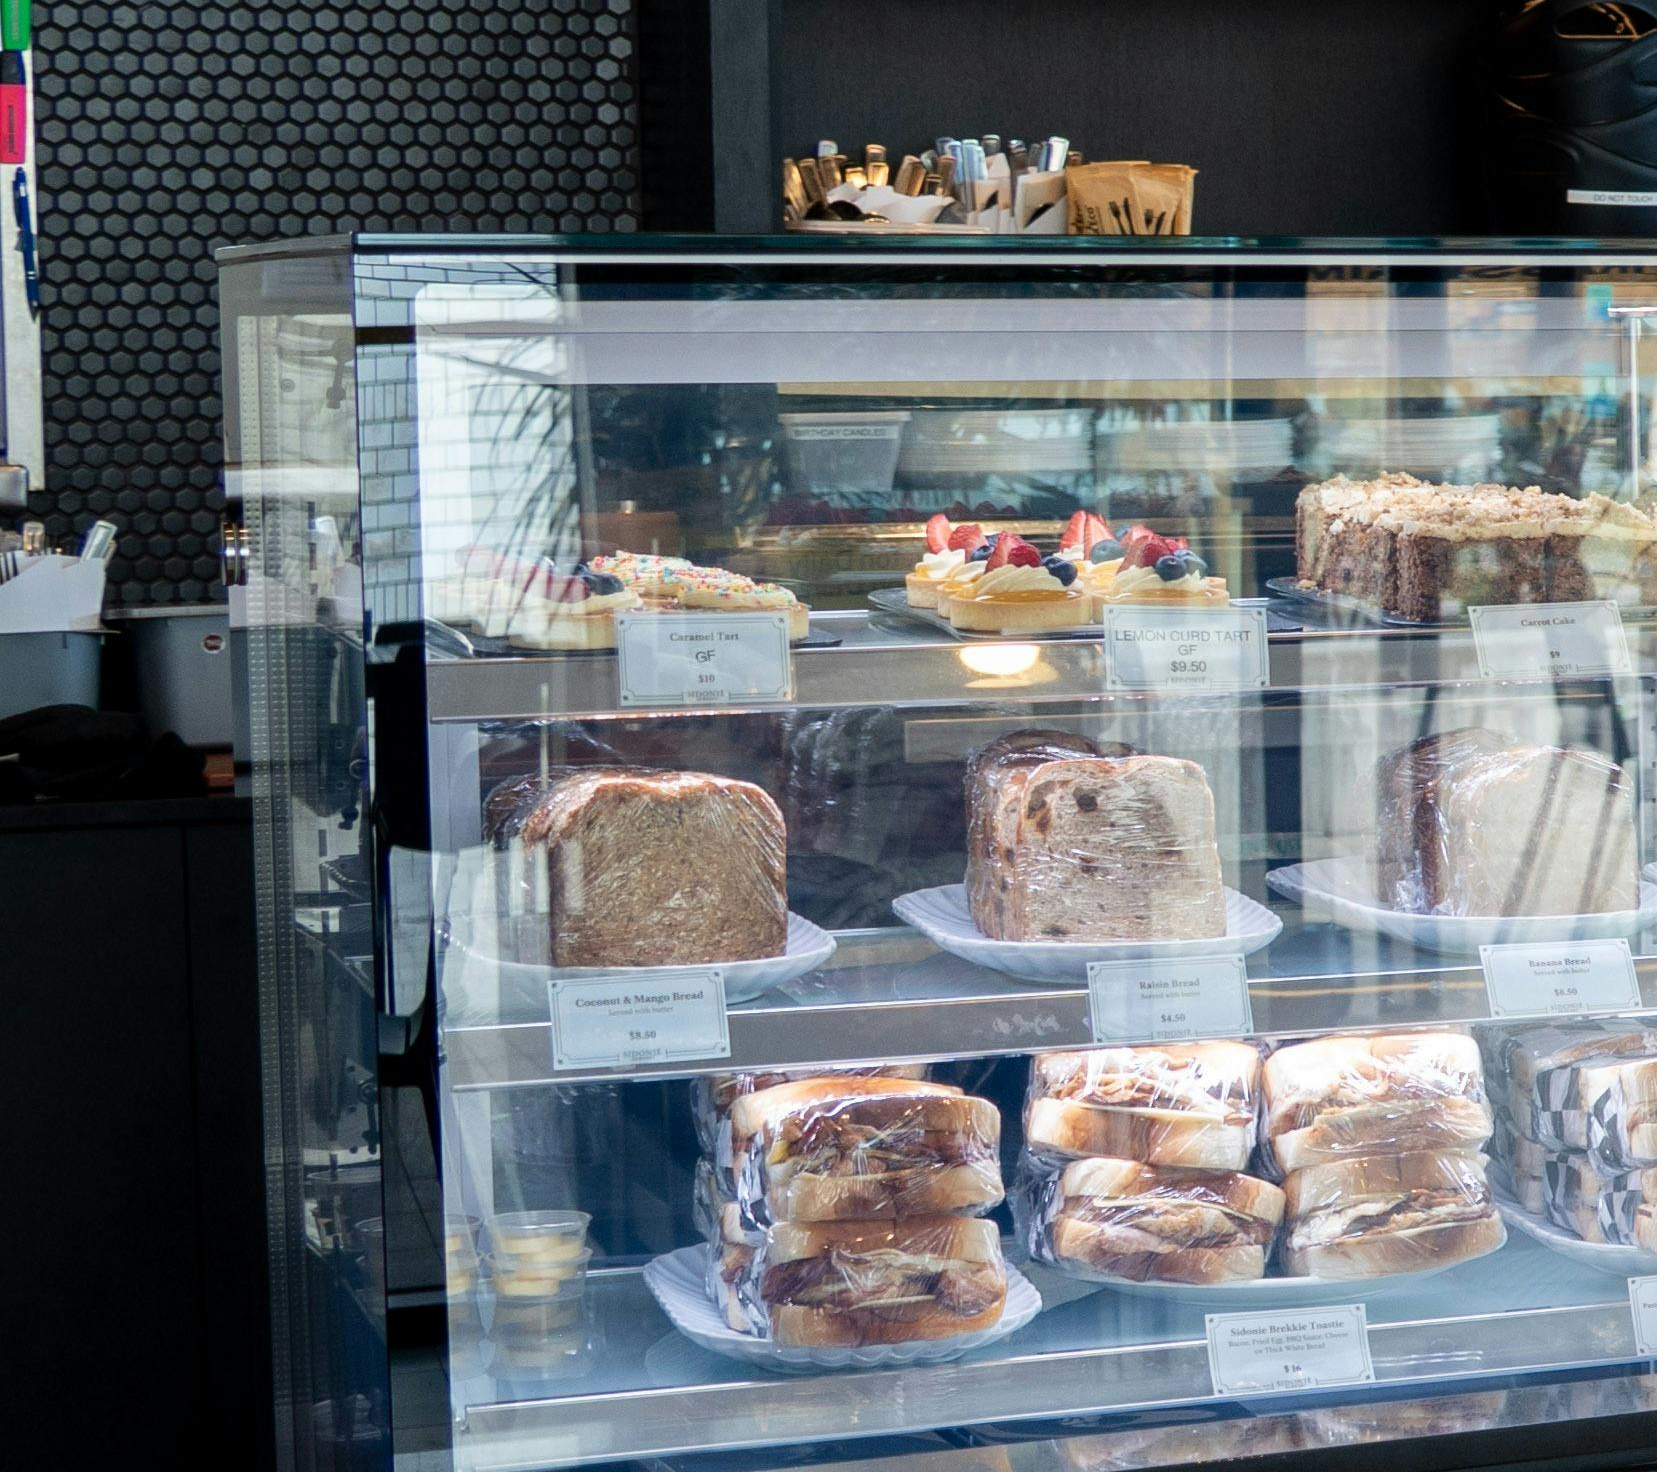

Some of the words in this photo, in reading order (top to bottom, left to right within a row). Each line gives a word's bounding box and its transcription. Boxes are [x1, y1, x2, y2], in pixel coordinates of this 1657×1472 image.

[669, 631, 714, 642] Caramel
[718, 632, 739, 641] Tart
[1115, 630, 1166, 642] LEMON
[1170, 630, 1211, 642] CURD
[1215, 630, 1251, 642] TART
[695, 649, 716, 663] GF
[1178, 644, 1197, 656] GF
[1170, 660, 1207, 673] $9.50
[698, 674, 715, 683] $10
[1139, 981, 1169, 990] Raisin
[1171, 978, 1200, 988] Bread
[575, 997, 621, 1008] Coconut
[634, 993, 671, 1004] Mango
[672, 991, 704, 1001] Bread
[1160, 1013, 1186, 1023] $4.50
